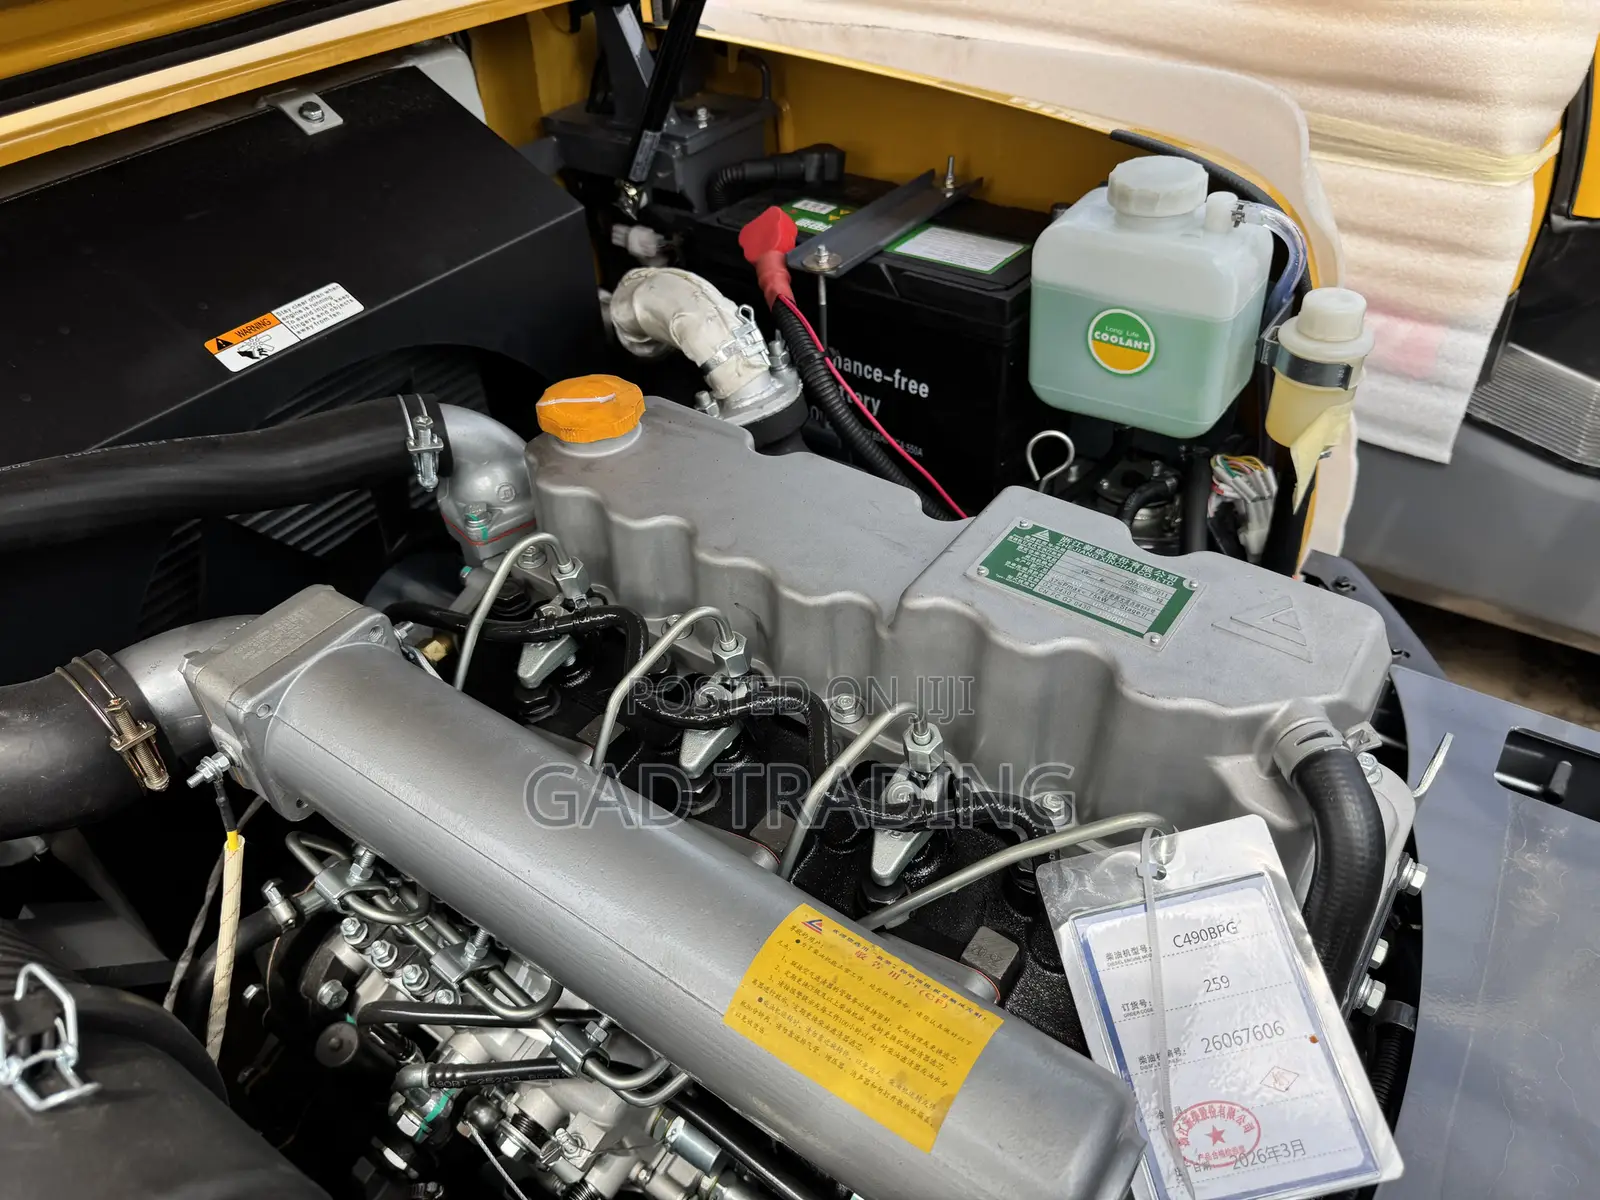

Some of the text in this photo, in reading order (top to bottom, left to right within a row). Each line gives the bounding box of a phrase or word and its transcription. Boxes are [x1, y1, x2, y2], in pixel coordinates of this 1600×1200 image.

[234, 317, 272, 339] WARNING
[1105, 325, 1140, 338] Long Life
[1094, 331, 1150, 351] COOLANT
[832, 354, 929, 398] nance-free
[1099, 556, 1136, 572] XINCHAI
[1172, 921, 1239, 949] C490BPG
[1203, 975, 1230, 993] 259
[1121, 998, 1152, 1012] 订货号：
[1201, 1020, 1285, 1054] 26067606
[1229, 1139, 1306, 1170] 2026年3月
